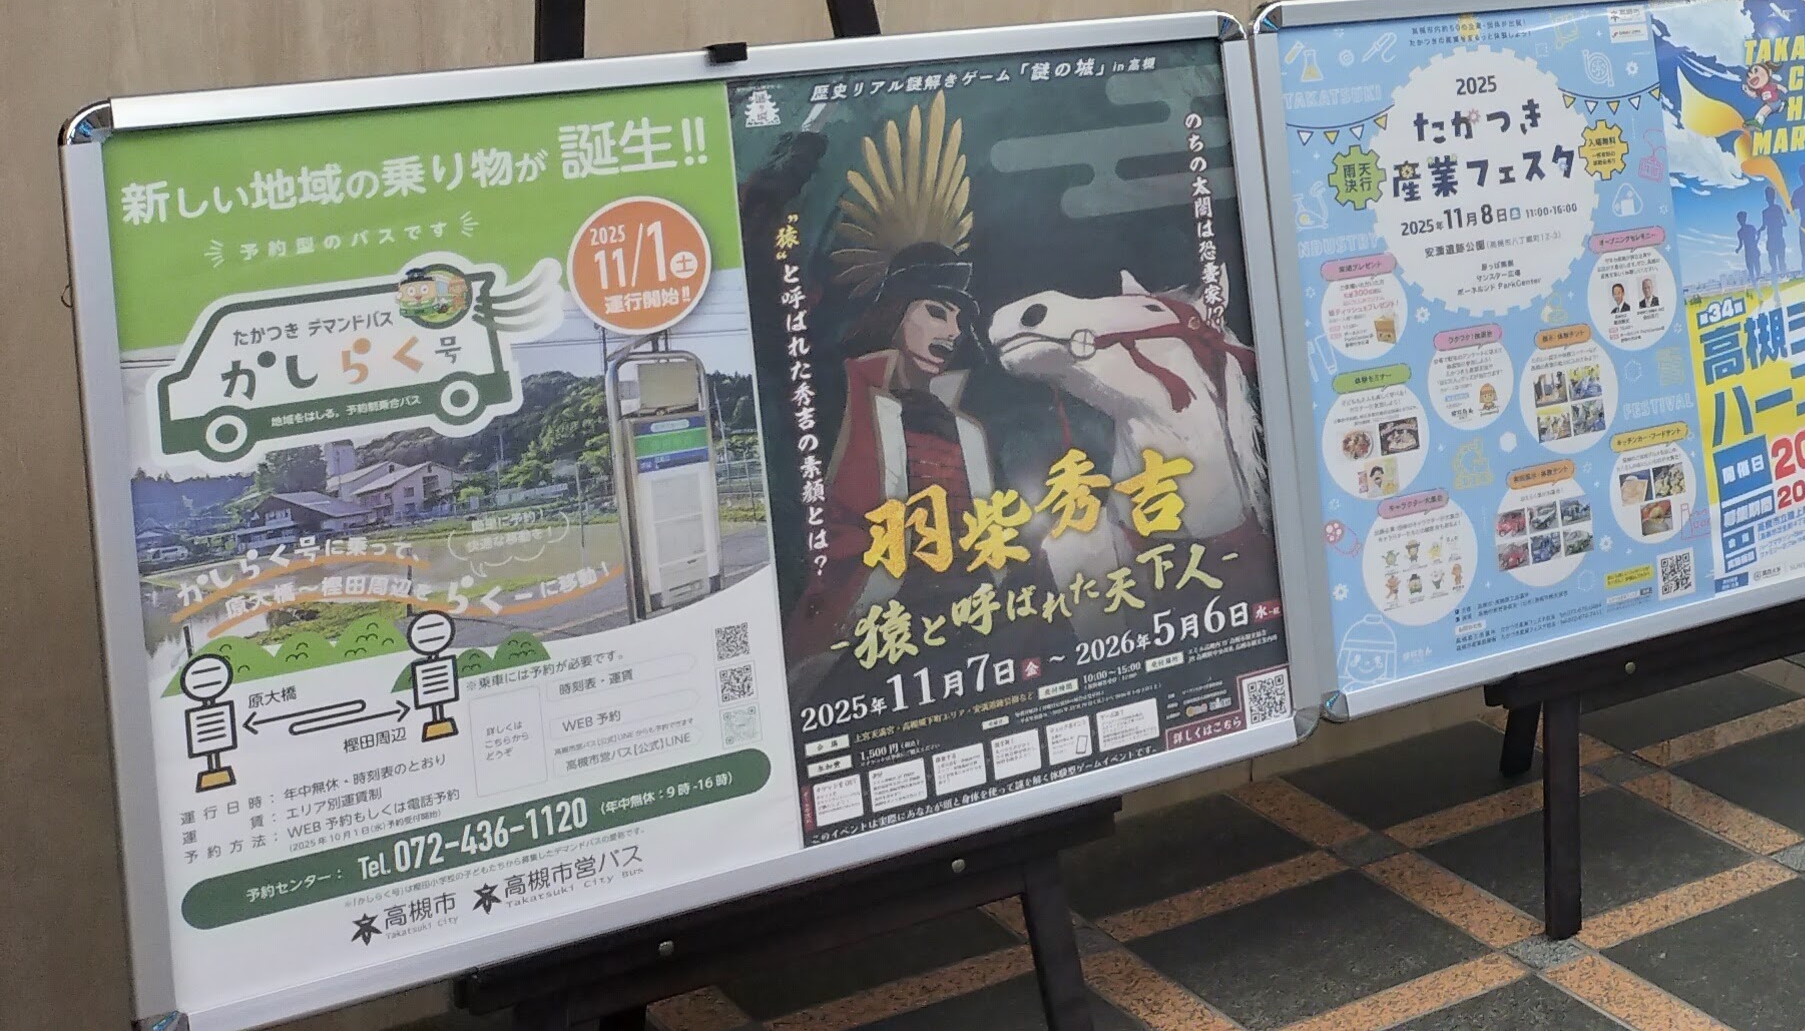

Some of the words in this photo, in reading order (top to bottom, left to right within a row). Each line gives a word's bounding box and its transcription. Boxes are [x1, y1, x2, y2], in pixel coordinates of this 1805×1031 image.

[1283, 84, 1382, 109] TAKATSUKI
[1456, 75, 1498, 96] 2025
[1413, 99, 1541, 143] たかつき
[1343, 162, 1371, 179] 雨天
[1392, 145, 1575, 203] 産業フェスタ
[121, 146, 547, 228] 新しい地域の乗り物が
[1344, 178, 1373, 194] 決行
[240, 219, 446, 262] 予約型のバスです
[590, 225, 626, 246] 2025
[233, 321, 299, 348] たかつき
[308, 310, 394, 337] デマンドバス
[1623, 395, 1694, 421] FESTIVAL
[1722, 454, 1764, 484] 開催日
[863, 448, 1194, 578] 羽柴秀吉
[559, 668, 634, 695] 時刻表・運賃
[248, 685, 297, 709] 原大橋
[486, 720, 522, 738] 詳しくは
[563, 715, 594, 732] WEB
[597, 709, 621, 726] 予約
[1173, 718, 1243, 746] 詳しくはこちら
[343, 726, 408, 754] 樫田周辺
[485, 732, 530, 749] こちらから
[486, 746, 513, 762] どうぞ
[284, 754, 446, 800] 年中無休・時刻表のとおり
[287, 788, 382, 821] エリア別運賃制
[384, 892, 457, 929] 高槻市
[505, 845, 643, 898] 高槻市営バス
[505, 885, 575, 909] Takatsuki
[583, 873, 613, 889] City
[621, 867, 644, 880] Bus
[386, 922, 433, 940] Takatsuki
[437, 915, 459, 929] City
